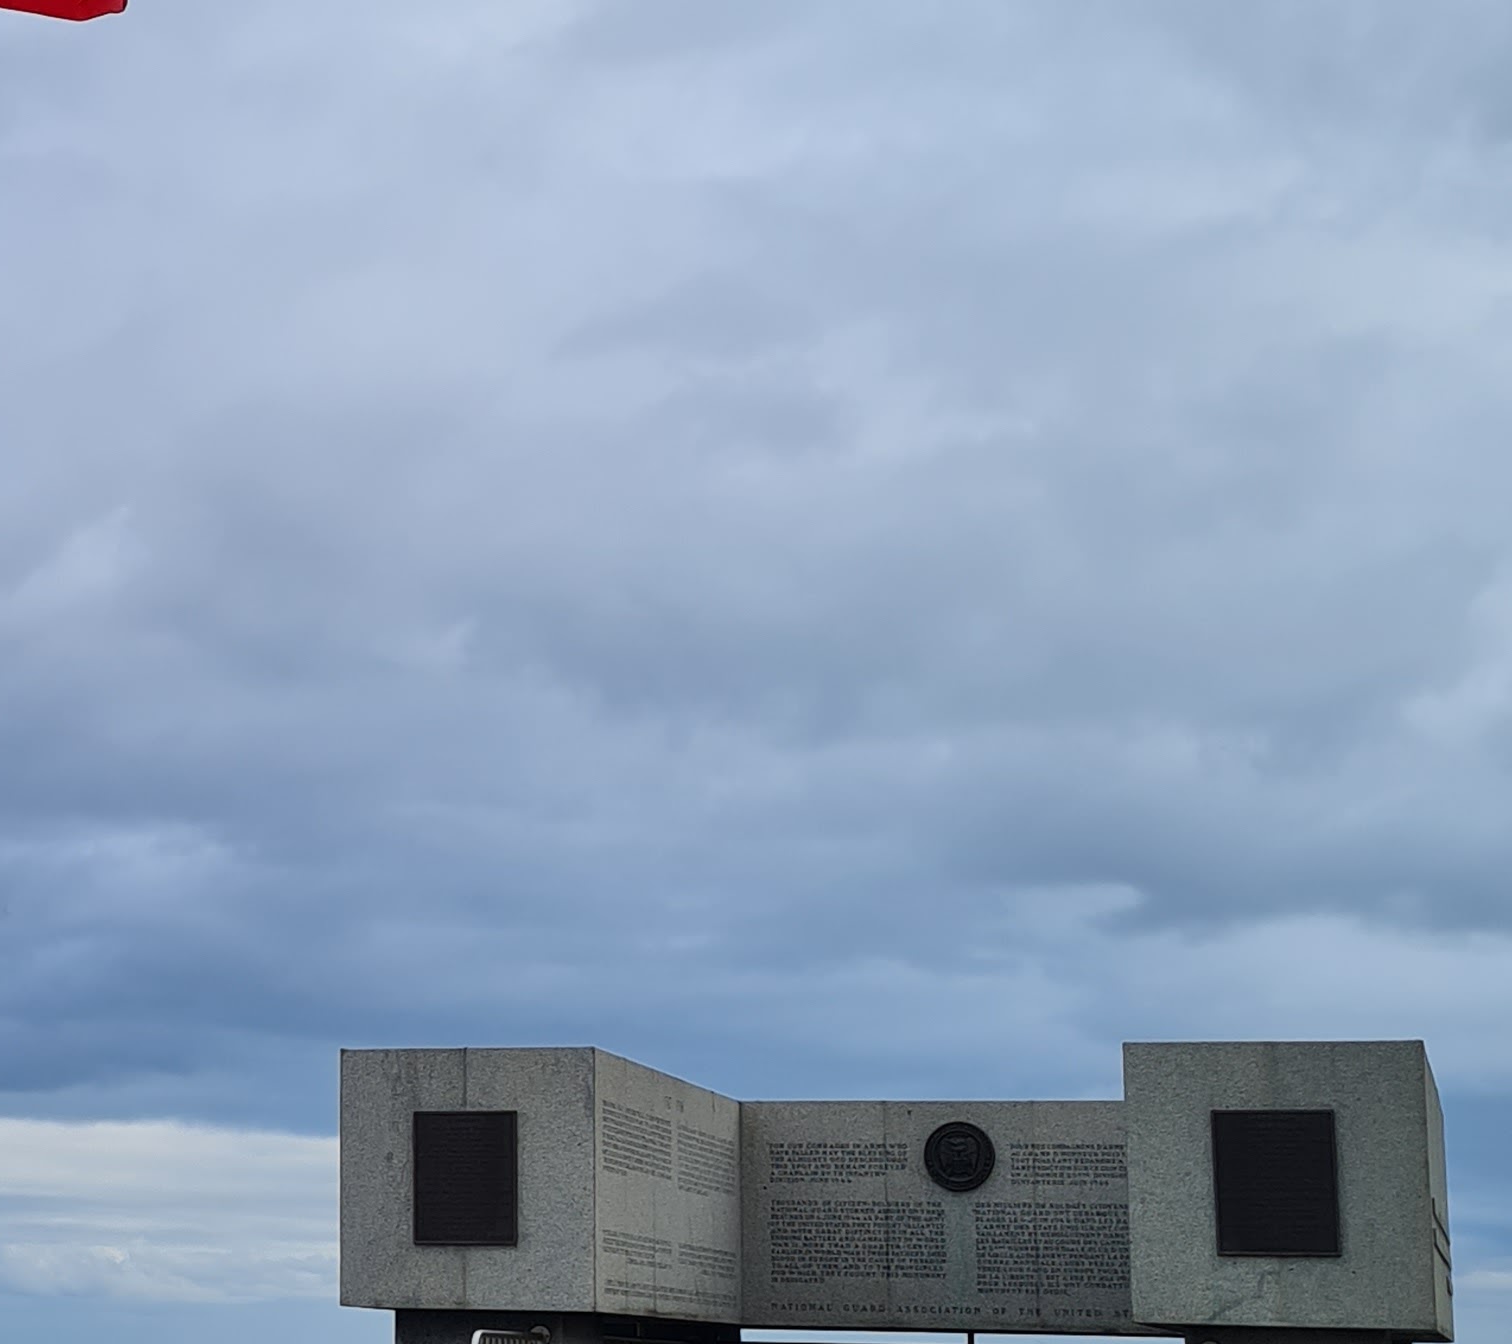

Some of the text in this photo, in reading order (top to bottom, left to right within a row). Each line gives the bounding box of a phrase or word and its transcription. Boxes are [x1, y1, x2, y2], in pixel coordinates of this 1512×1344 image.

[771, 1303, 832, 1312] NATIONAL
[843, 1304, 886, 1313] GUARD
[897, 1306, 981, 1315] ASSOCIATION
[992, 1307, 1006, 1316] OF
[1019, 1307, 1042, 1316] THE
[1054, 1308, 1103, 1317] UNITED
